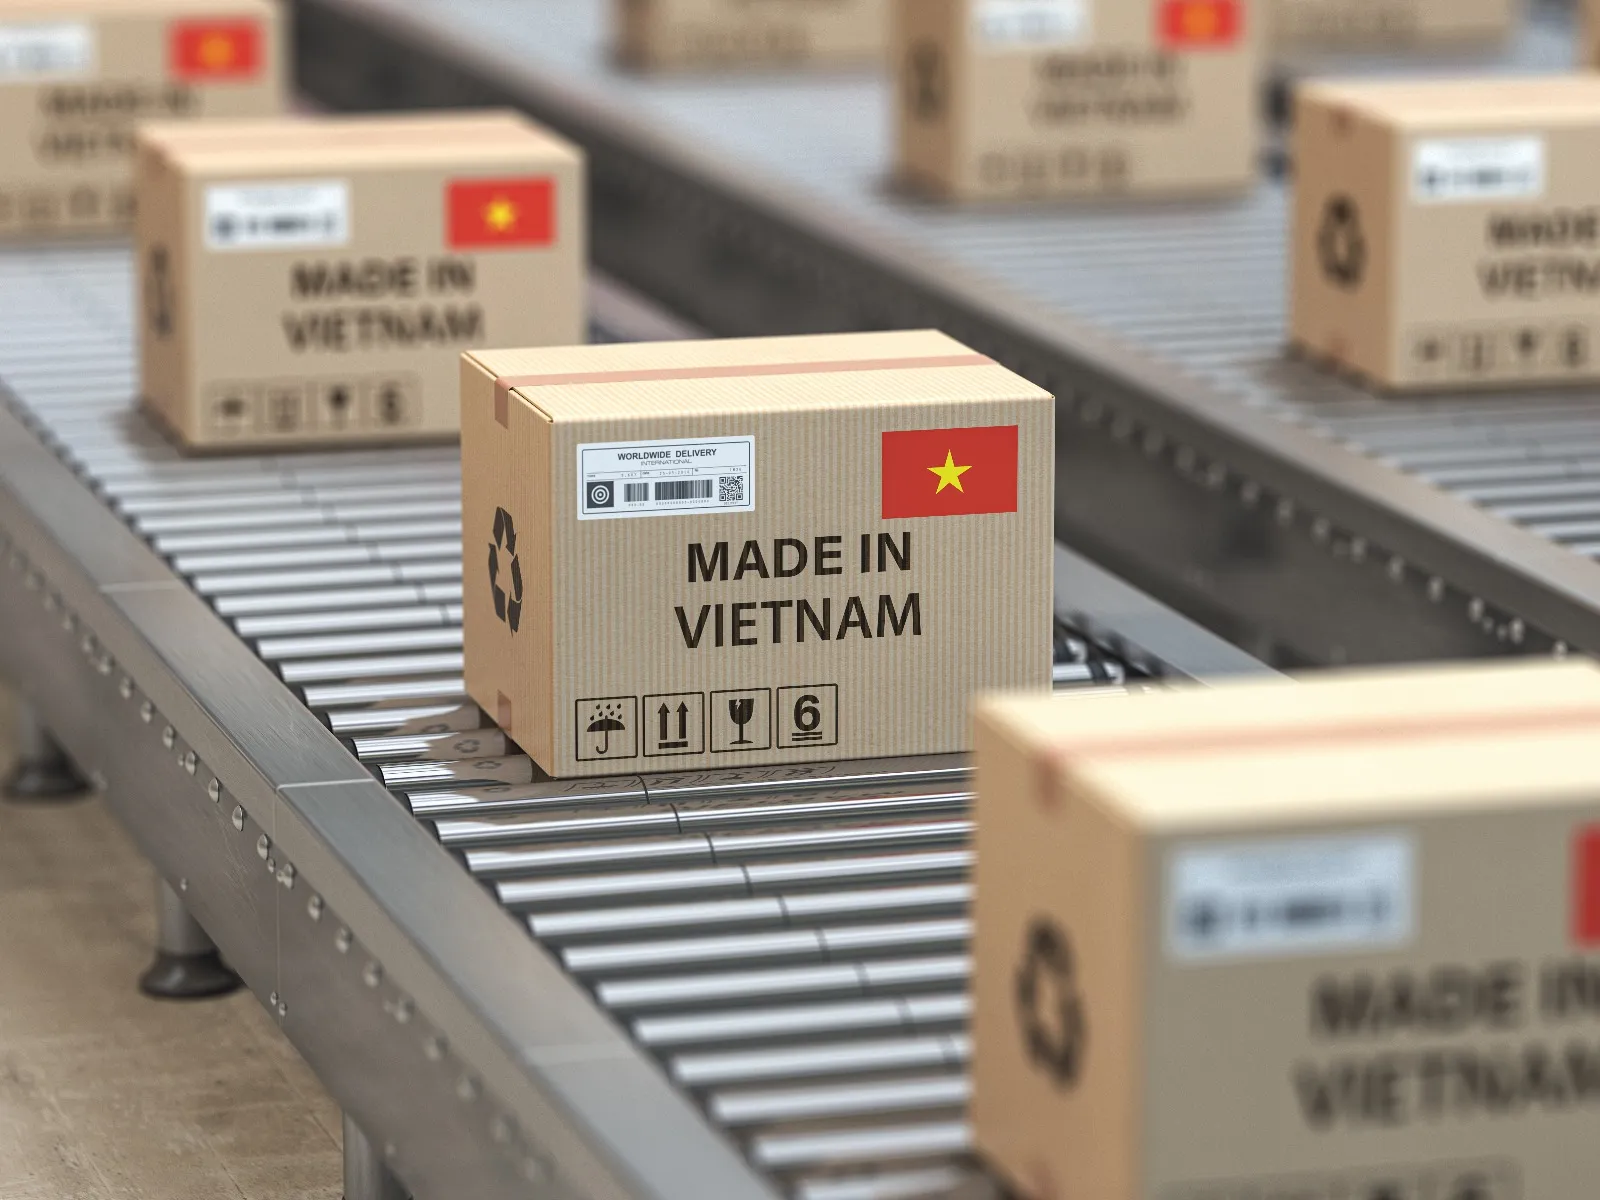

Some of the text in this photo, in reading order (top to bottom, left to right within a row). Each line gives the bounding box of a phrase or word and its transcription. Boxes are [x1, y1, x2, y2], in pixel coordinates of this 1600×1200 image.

[617, 448, 717, 461] WORLDWIDE DELIVERY
[640, 458, 692, 466] INTERNATIONAL
[687, 531, 911, 583] MADE IN
[674, 592, 922, 649] VIETNAM
[794, 694, 821, 731] 6
